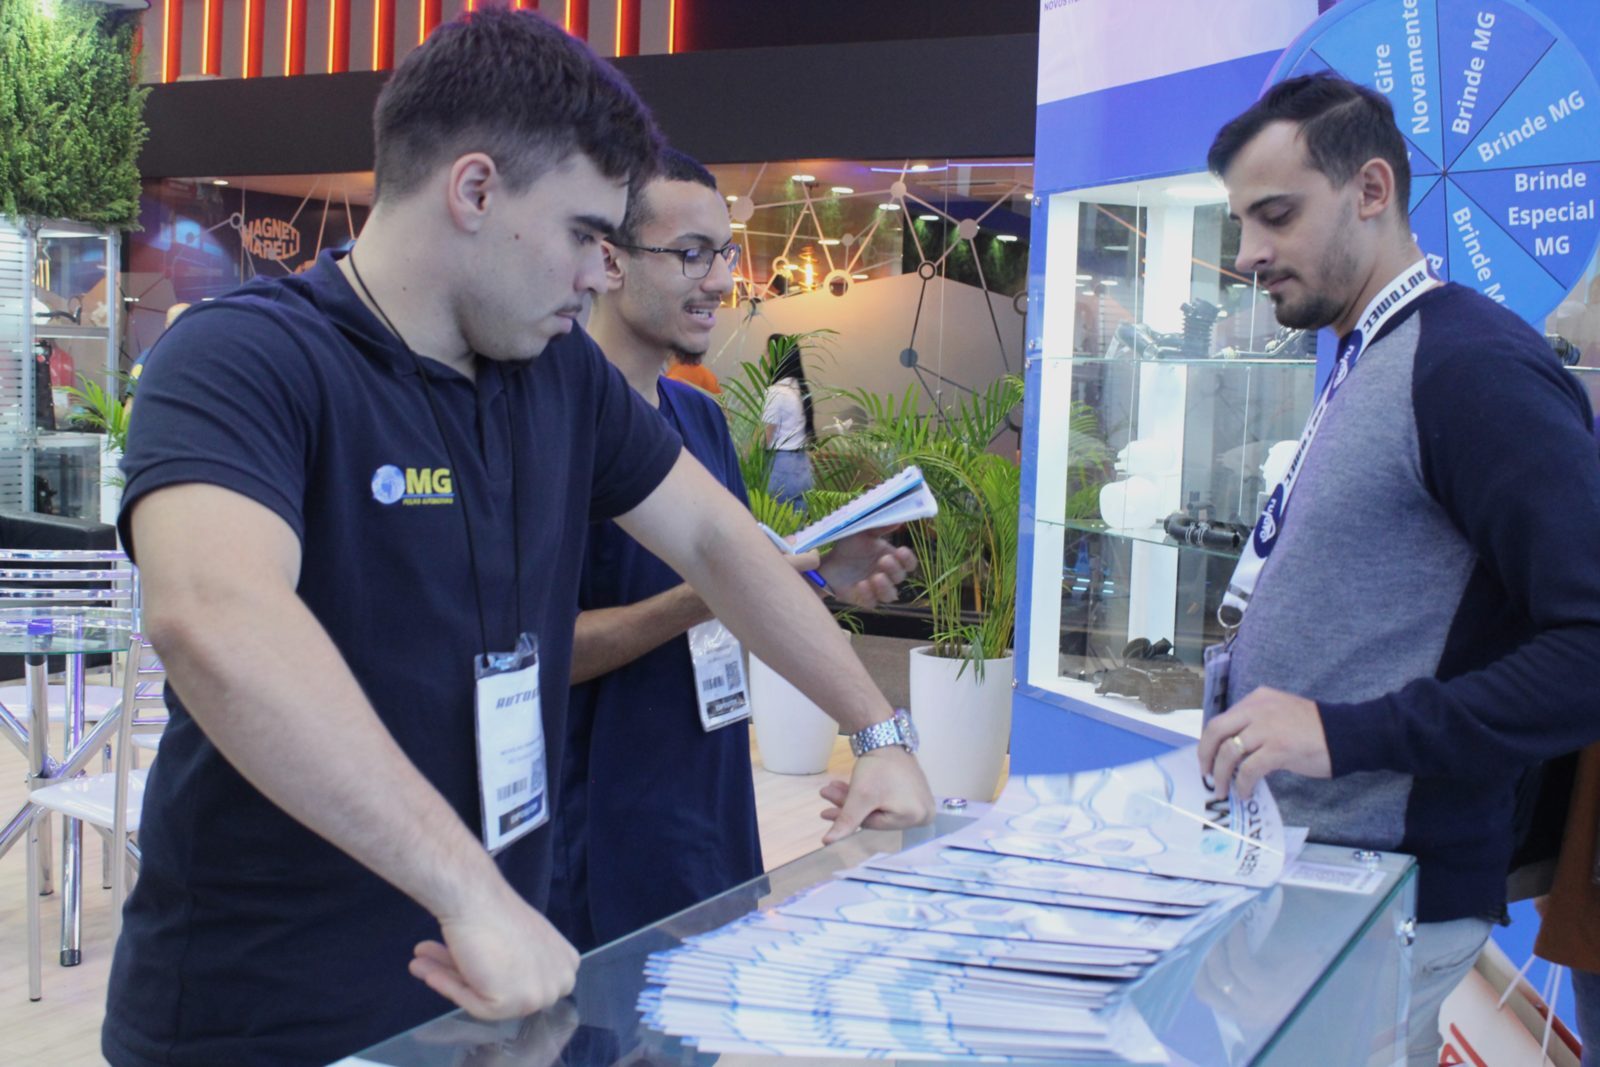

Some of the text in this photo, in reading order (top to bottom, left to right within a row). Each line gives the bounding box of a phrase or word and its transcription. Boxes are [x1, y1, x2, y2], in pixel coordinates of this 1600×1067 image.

[1374, 44, 1394, 93] Gire
[1402, 0, 1430, 134] Novamente
[1451, 11, 1496, 135] Brinde MG
[1477, 90, 1585, 163] Brinde MG
[1515, 168, 1587, 193] Brinde
[1508, 199, 1595, 230] Especial
[1452, 206, 1509, 309] Brinde M
[1535, 235, 1570, 257] MG
[1363, 270, 1426, 333] AUTOMEC
[405, 467, 452, 494] MG
